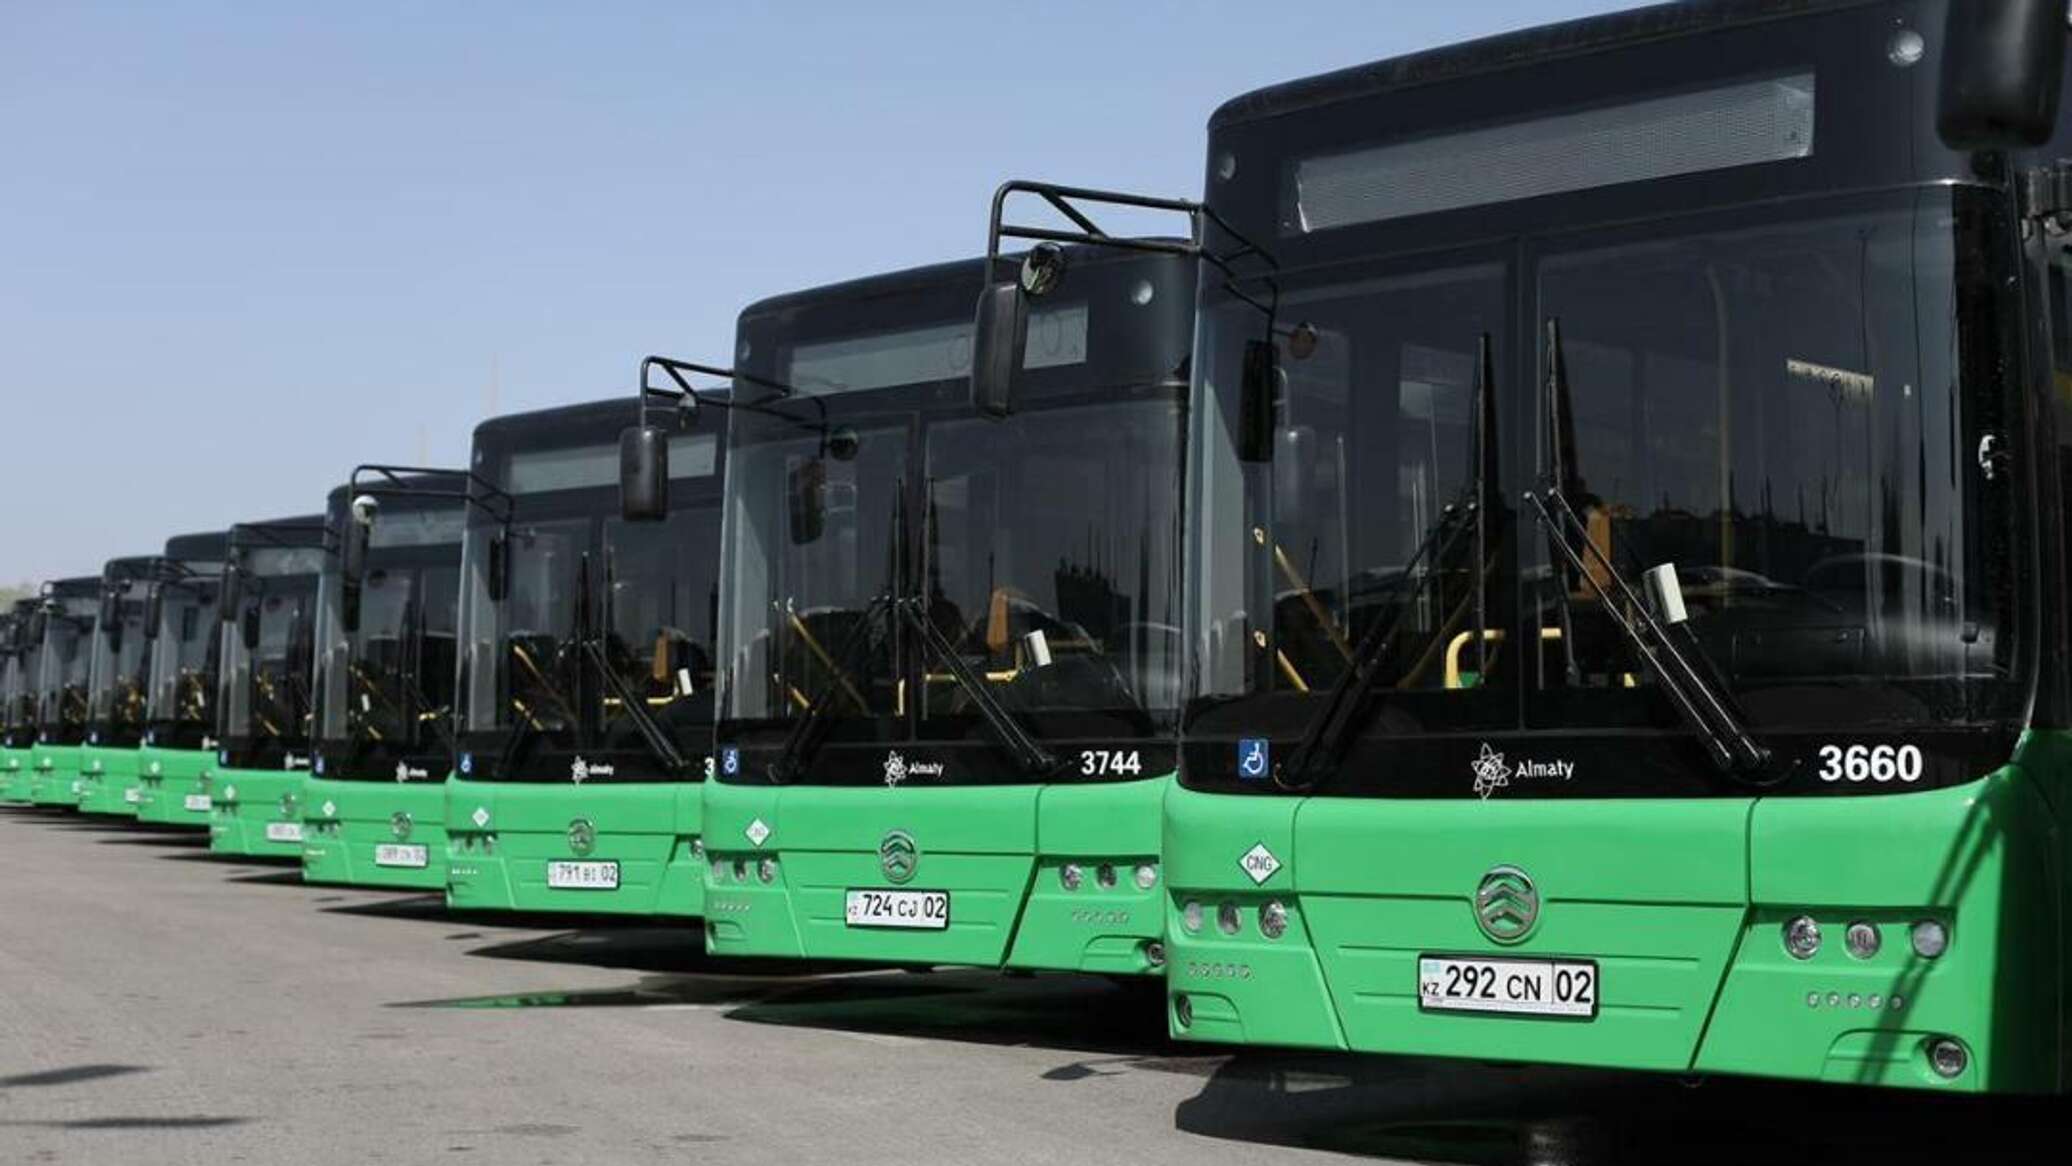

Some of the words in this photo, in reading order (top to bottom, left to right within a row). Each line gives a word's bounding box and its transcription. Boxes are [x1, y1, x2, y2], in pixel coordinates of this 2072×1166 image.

[1080, 750, 1142, 775] 3744
[1515, 759, 1574, 780] Almaty
[1819, 744, 1923, 782] 3660
[1246, 854, 1273, 871] CNG
[863, 894, 892, 917] 724
[923, 896, 946, 919] 02
[1422, 982, 1440, 996] KZ
[1445, 965, 1497, 998] 292
[1506, 974, 1541, 1001] CN
[1556, 970, 1592, 1004] 02
